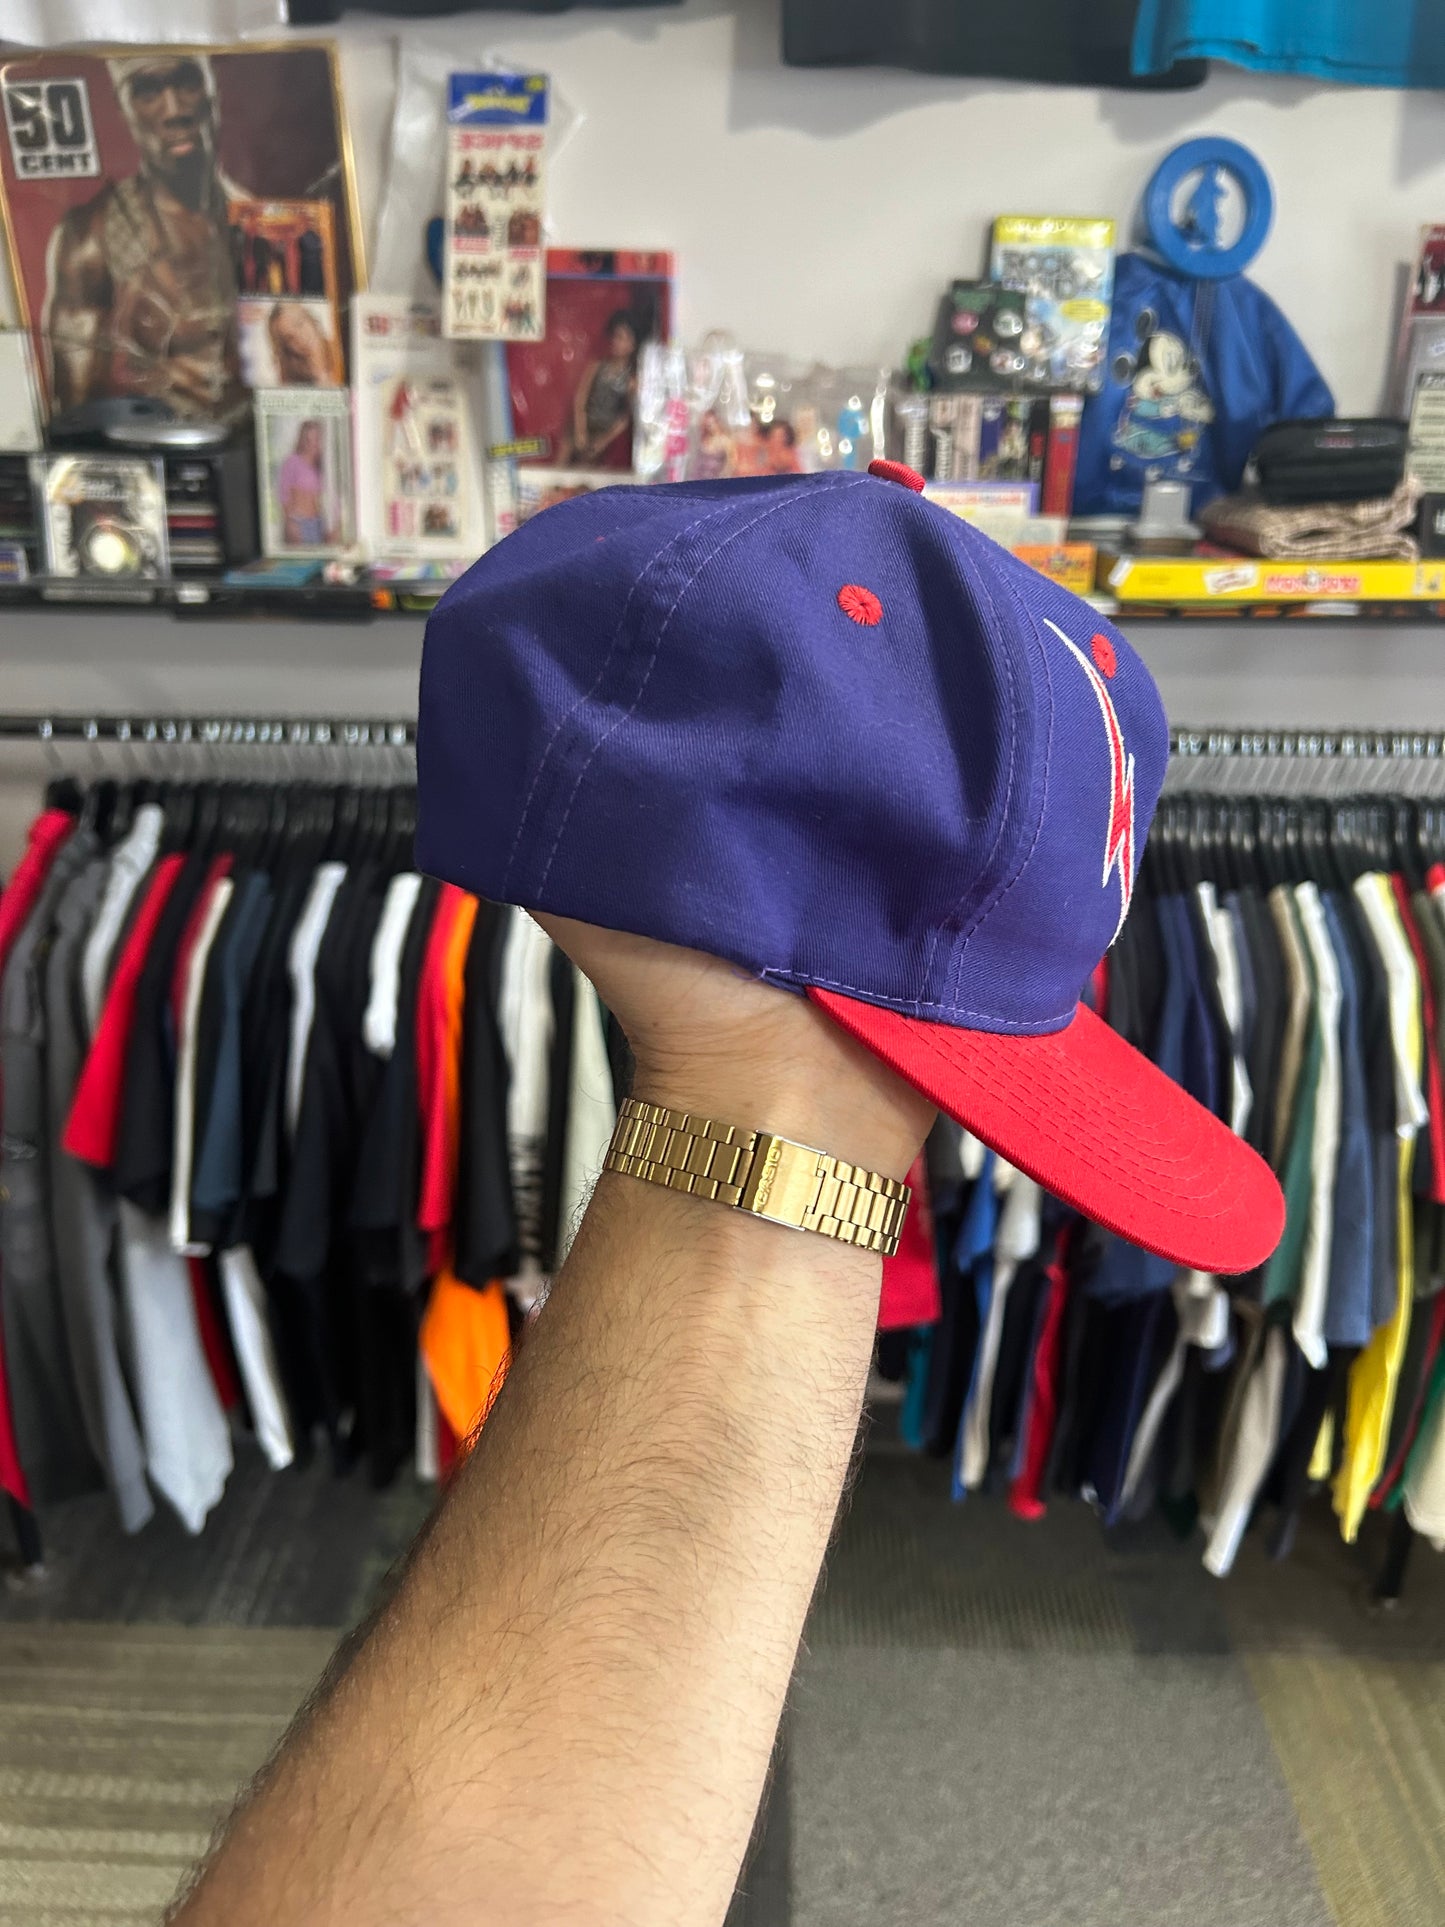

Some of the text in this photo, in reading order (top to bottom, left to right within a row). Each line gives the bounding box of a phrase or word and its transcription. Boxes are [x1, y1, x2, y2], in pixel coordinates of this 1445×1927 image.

[7, 85, 86, 149] 50
[20, 152, 91, 174] CENT
[755, 1146, 782, 1206] CASIO
